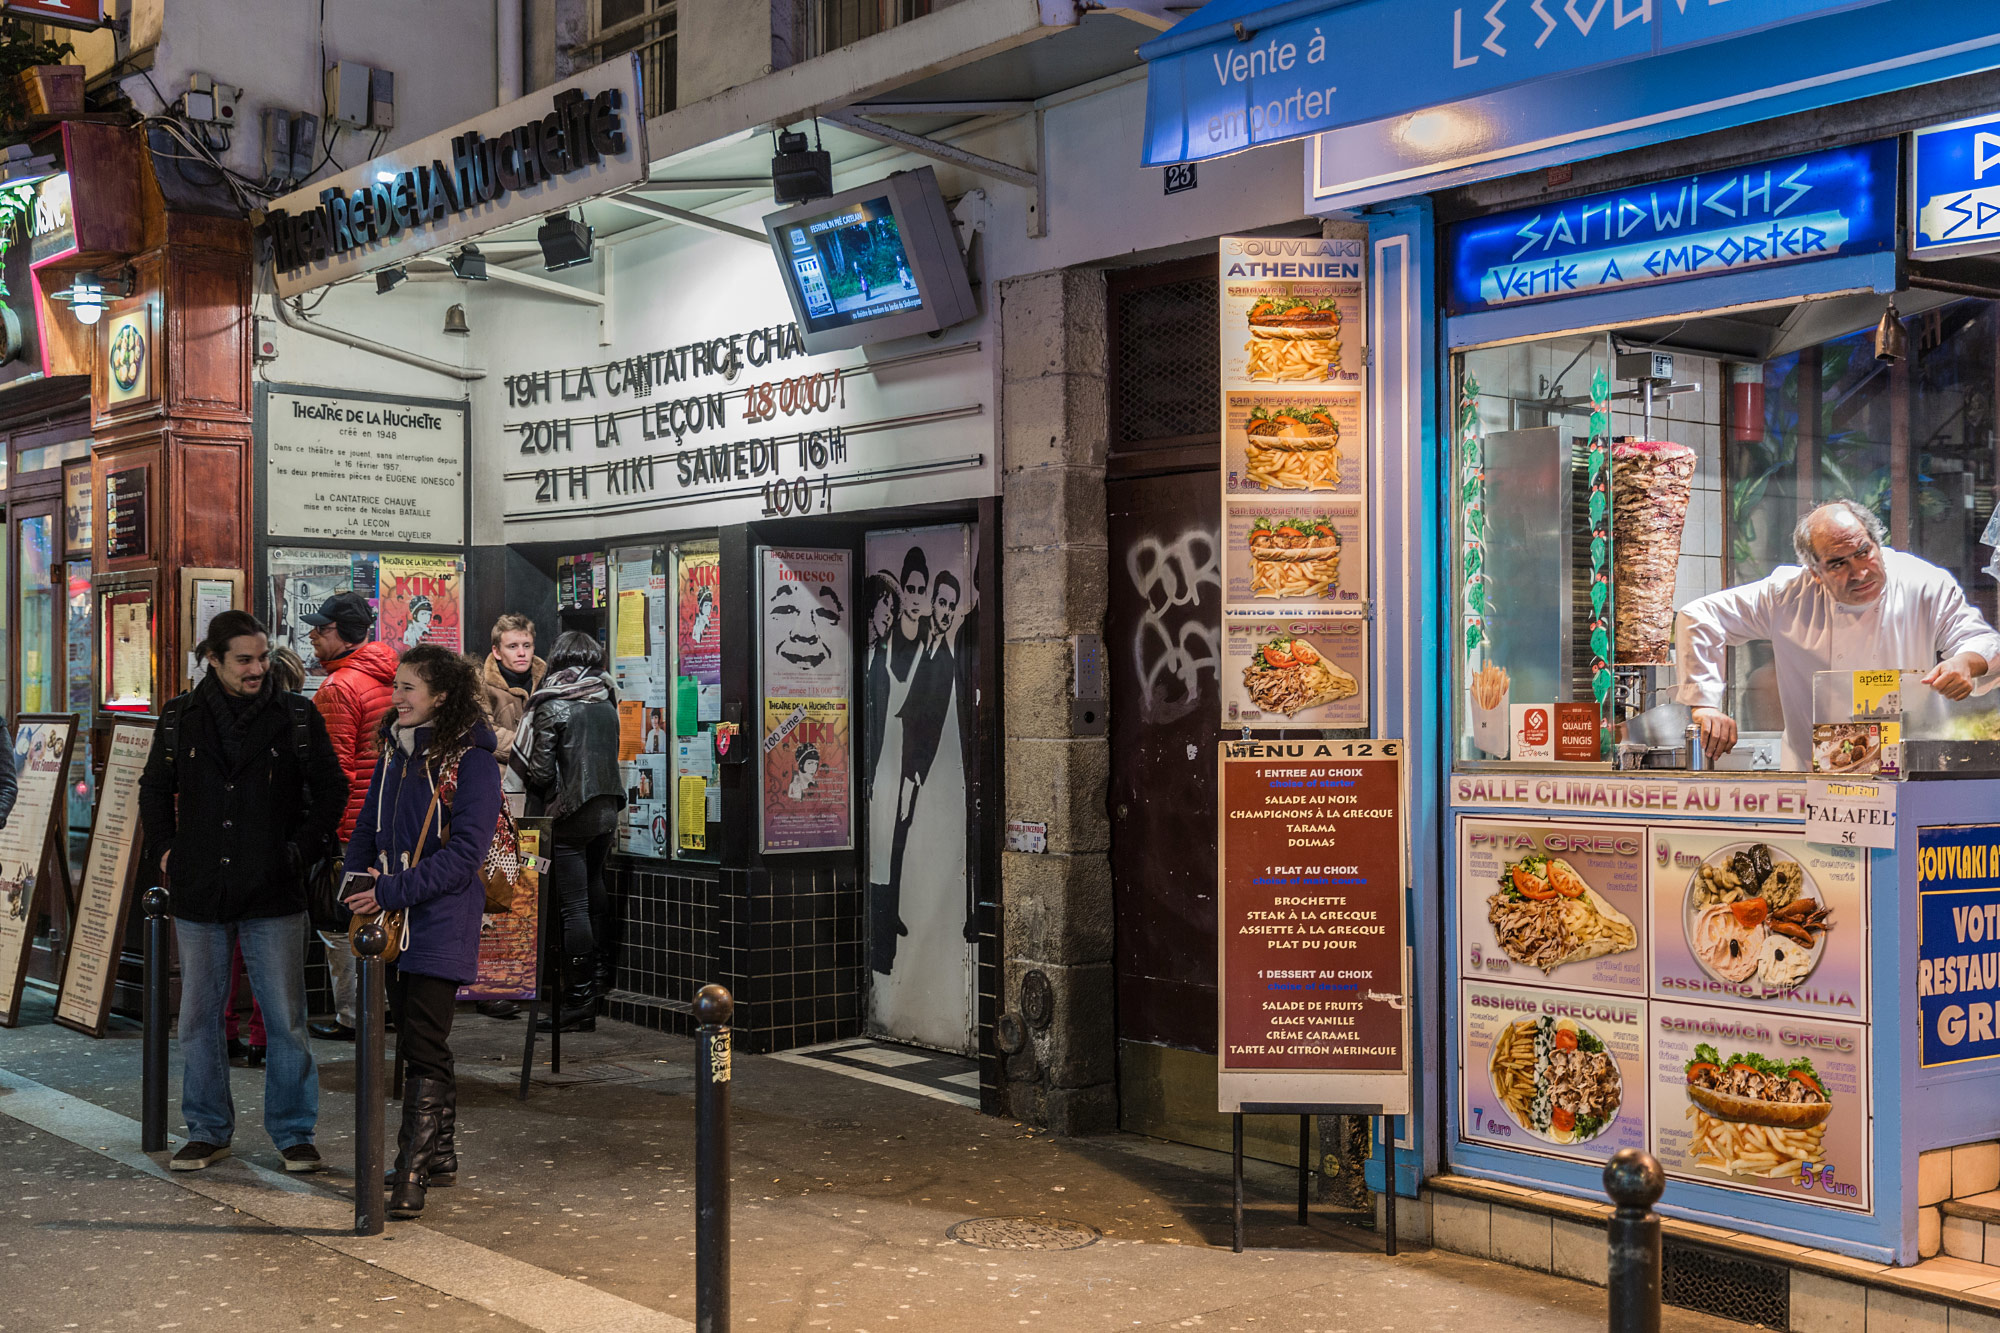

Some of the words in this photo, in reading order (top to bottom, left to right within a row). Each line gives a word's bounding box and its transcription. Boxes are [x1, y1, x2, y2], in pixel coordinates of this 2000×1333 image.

[1213, 41, 1296, 86] Vente
[1307, 28, 1326, 65] à
[1208, 86, 1337, 142] emporter
[451, 88, 627, 212] HUCHETTE
[1168, 164, 1192, 187] 23
[1512, 163, 1813, 262] SANDWICHS
[1227, 240, 1361, 258] SOUVLAKI
[1492, 258, 1579, 302] VENTE
[1600, 258, 1624, 285] A
[1643, 219, 1828, 279] EMPORTER
[1227, 262, 1359, 279] ATHENIEN
[1228, 285, 1287, 297] sandwich
[1293, 285, 1358, 297] MERGUEZ
[505, 370, 551, 407] 19H
[561, 367, 596, 401] LA
[605, 333, 744, 398] CANTATRICE
[747, 322, 808, 367] CHA
[1327, 363, 1337, 381] 5
[292, 401, 342, 421] THEATRE
[346, 409, 364, 423] DE
[367, 411, 380, 425] LA
[384, 410, 442, 430] HUCHETTE
[520, 418, 572, 454] 20H
[595, 412, 621, 448] LA
[642, 392, 726, 446] LEÇON
[339, 426, 358, 436] créé
[377, 430, 397, 440] 1948
[274, 443, 292, 452] Dans
[308, 444, 334, 455] théâtre
[377, 452, 393, 460] sans
[396, 453, 434, 464] interruption
[437, 456, 458, 465] depuis
[606, 455, 654, 495] KIKI
[676, 436, 779, 488] SAMEDI
[291, 468, 307, 476] deux
[311, 468, 345, 480] premières
[349, 471, 371, 481] pièces
[386, 474, 417, 485] EUGENE
[421, 476, 455, 487] IONESCO
[1228, 471, 1238, 489] 5
[329, 493, 380, 505] CANTATRICE
[384, 496, 417, 507] CHAUVE
[303, 503, 320, 511] mise
[335, 502, 356, 513] scène
[371, 506, 396, 515] Nicolas
[399, 508, 431, 518] BATAILLE
[348, 518, 359, 526] LA
[363, 519, 390, 528] LEÇON
[303, 526, 320, 534] mise
[371, 528, 395, 538] Marcel
[398, 530, 432, 540] CUVELIER
[778, 564, 835, 583] ionesco
[395, 576, 446, 597] KIKI
[1327, 583, 1337, 600] 5
[1225, 608, 1275, 616] viande
[1279, 608, 1303, 616] fait
[1307, 608, 1362, 616] maison
[1228, 622, 1284, 635] PITA
[1288, 621, 1361, 635] GREC
[1859, 673, 1894, 685] apetiz
[809, 701, 836, 711] HUCHETTE
[1228, 701, 1238, 719] 5
[1241, 708, 1261, 719] euro
[1562, 721, 1593, 731] QUALITÉ
[1562, 736, 1593, 745] RUNGIS
[1225, 743, 1304, 759] MENU
[1313, 744, 1333, 757] A
[1342, 744, 1373, 757] 12
[1381, 743, 1398, 757] €
[1264, 769, 1307, 778] ENTREE
[1310, 769, 1325, 778] AU
[1328, 768, 1363, 778] CHOIX
[1319, 780, 1356, 788] starter
[1265, 795, 1307, 804] SALADE
[1309, 795, 1326, 804] AU
[1328, 795, 1358, 804] NOIX
[1458, 778, 1529, 803] SALLE
[1535, 780, 1679, 811] CLIMATISEE
[1683, 786, 1721, 812] AU
[1729, 787, 1770, 813] 1er
[1229, 810, 1313, 819] CHAMPIGNONS
[1326, 810, 1341, 819] LA
[1343, 809, 1393, 819] GRECQUE
[1808, 805, 1896, 826] FALAFEL
[1286, 824, 1336, 833] TARAMA
[1288, 838, 1336, 848] DOLMAS
[1469, 831, 1538, 850] PITA
[1543, 832, 1640, 855] GREC
[1841, 831, 1857, 844] 5€
[1656, 838, 1670, 867] 9
[1274, 866, 1302, 875] PLAT
[1305, 866, 1321, 875] AU
[1323, 866, 1359, 875] CHOIX
[1918, 844, 1987, 882] SOUVLAKI
[1303, 877, 1329, 885] main
[1274, 896, 1347, 906] BROCHETTE
[1247, 911, 1286, 920] STEAK
[1301, 911, 1315, 920] LA
[1319, 911, 1377, 921] GRECQUE
[1952, 903, 2000, 944] VOT
[1239, 925, 1294, 935] ASSIETTE
[1309, 925, 1325, 935] LA
[1328, 925, 1386, 936] GRECQUE
[1267, 940, 1299, 949] PLAT
[1302, 940, 1321, 949] DU
[1323, 940, 1357, 950] JOUR
[1470, 942, 1482, 969] 5
[1486, 957, 1510, 971] euro
[1266, 970, 1316, 979] DESSERT
[1319, 970, 1335, 979] AU
[1337, 970, 1373, 979] CHOIX
[1920, 952, 2000, 997] RESTAU
[1318, 982, 1359, 991] dessert
[1662, 975, 1754, 997] assiette
[1761, 985, 1857, 1009] PIKILIA
[1262, 1001, 1305, 1011] SALADE
[1308, 1001, 1322, 1010] DE
[1325, 1001, 1364, 1011] FRUITS
[1471, 993, 1538, 1013] assiette
[1542, 999, 1638, 1026] GRECQUE
[1271, 1016, 1305, 1026] GLACE
[1307, 1016, 1355, 1026] VANILLE
[1266, 1028, 1303, 1040] CRÈME
[1306, 1031, 1360, 1041] CARAMEL
[1660, 1015, 1771, 1041] sandwich
[1778, 1026, 1855, 1052] GREC
[1230, 1045, 1265, 1055] TARTE
[1268, 1046, 1285, 1055] AU
[1287, 1045, 1330, 1055] CITRON
[1332, 1046, 1397, 1056] MERINGUIE
[1473, 1107, 1484, 1131] 7
[1801, 1161, 1815, 1190] 5
